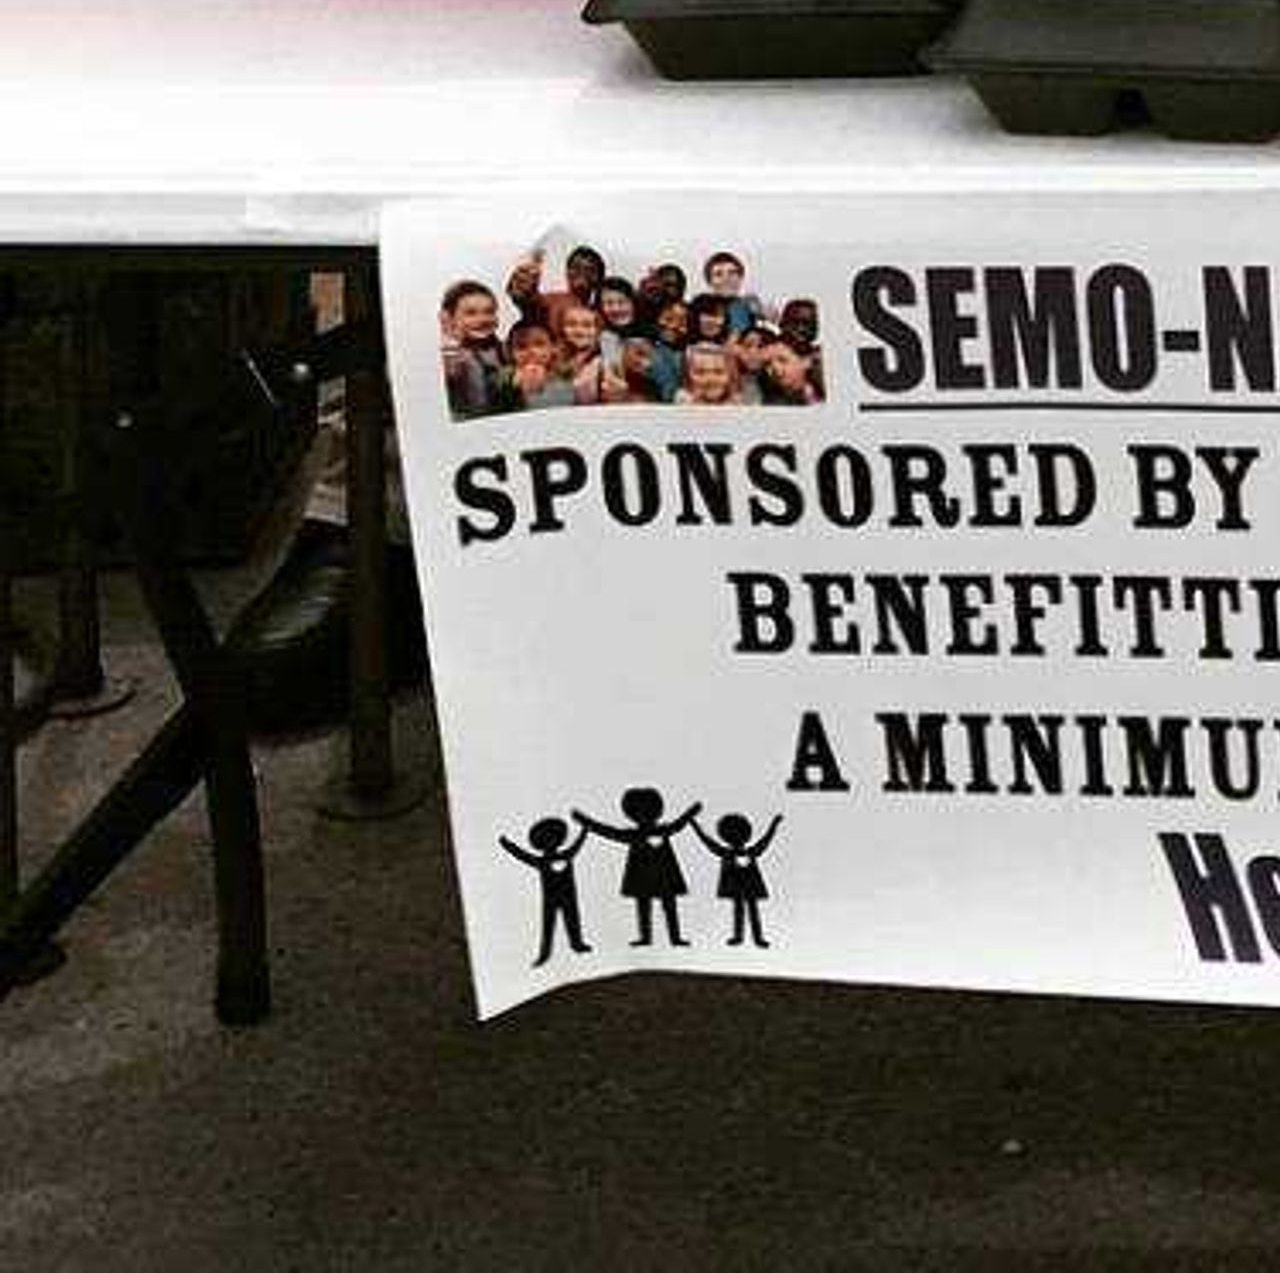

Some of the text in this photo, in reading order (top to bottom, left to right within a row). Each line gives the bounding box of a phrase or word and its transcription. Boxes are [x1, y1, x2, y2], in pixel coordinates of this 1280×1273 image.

[453, 442, 1097, 547] SPONSORED
[1126, 443, 1261, 532] BY
[785, 711, 851, 793] A
